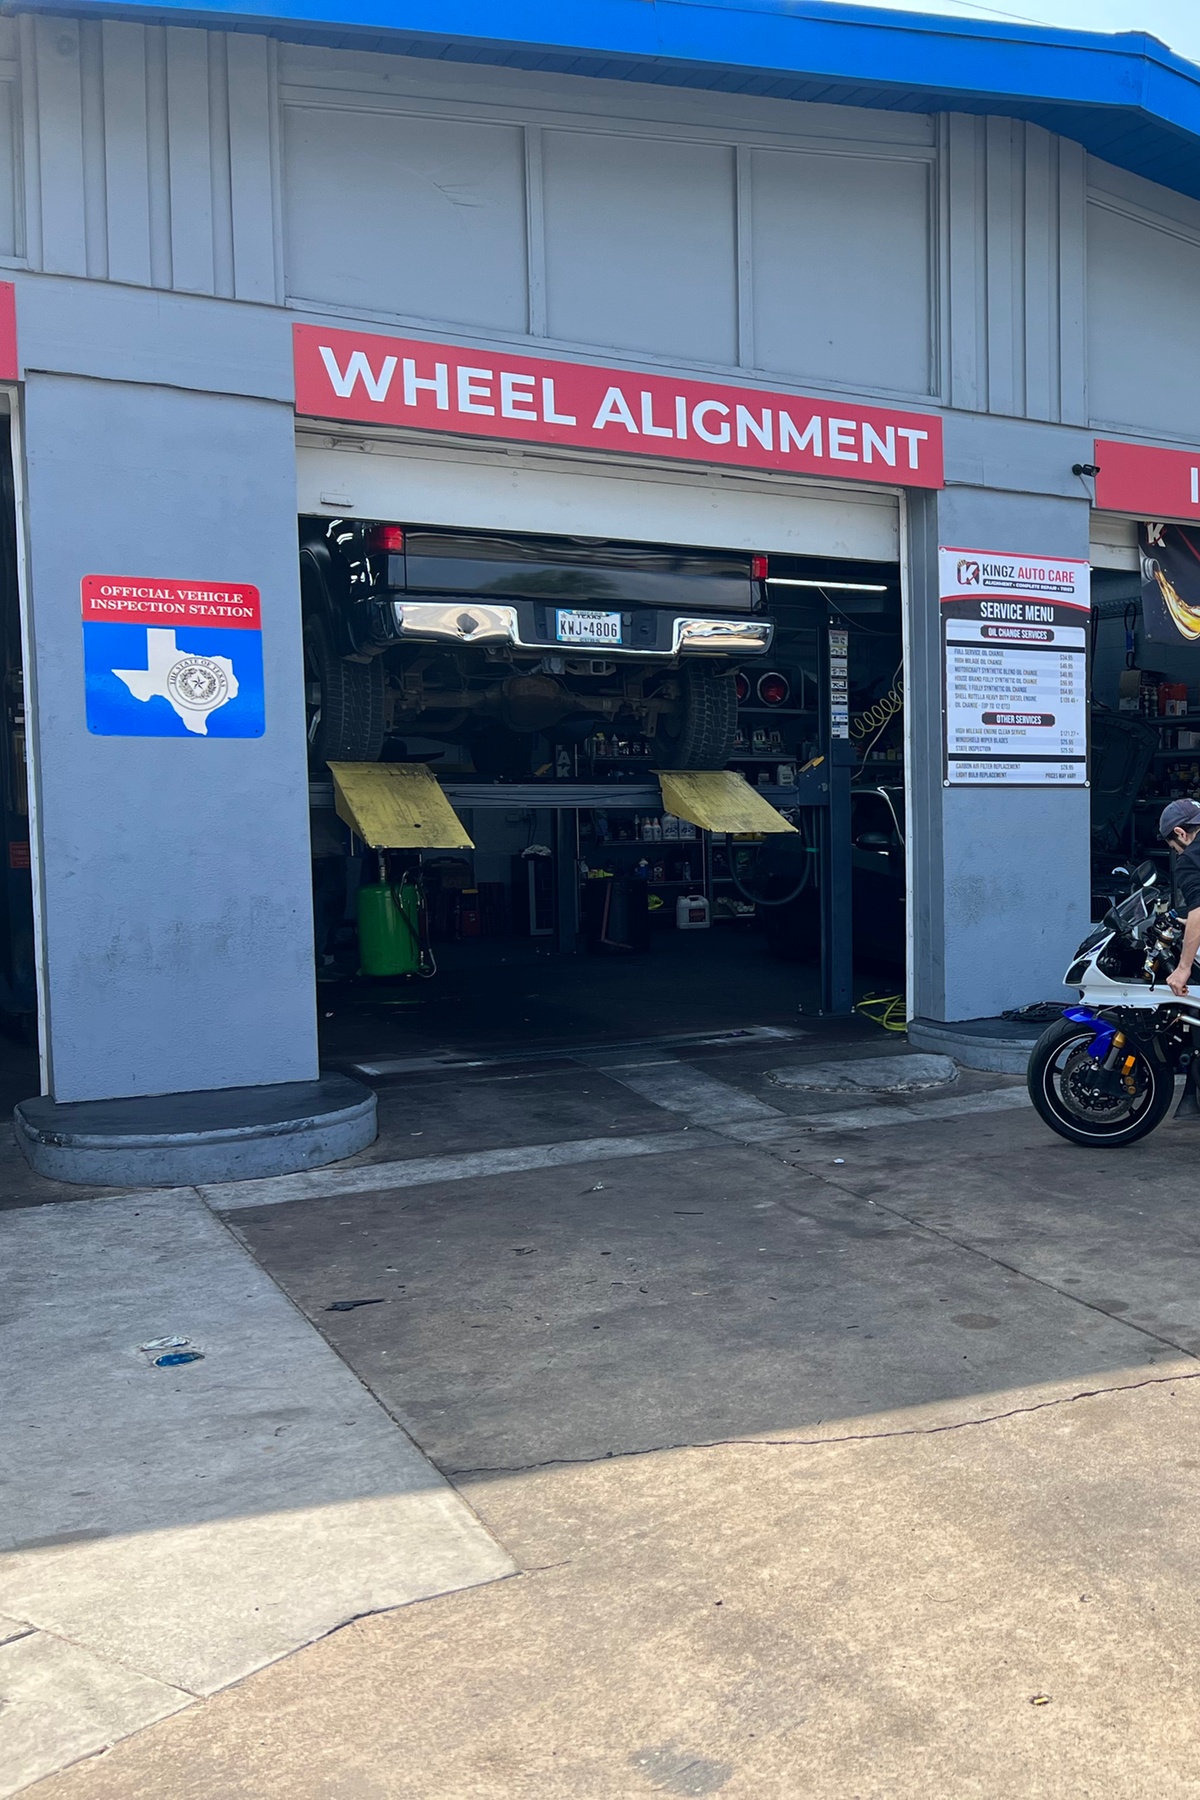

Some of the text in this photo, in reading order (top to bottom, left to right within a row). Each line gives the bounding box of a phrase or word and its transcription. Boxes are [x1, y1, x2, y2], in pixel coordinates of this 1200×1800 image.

[318, 346, 928, 469] WHEEL ALIGNMENT
[983, 564, 1014, 578] KINGZ
[1018, 567, 1044, 581] AUTO
[1048, 570, 1074, 583] CARE
[100, 586, 243, 603] OFFICIAL VEHICLE
[90, 599, 253, 617] INSPECTION STATION
[980, 602, 1054, 622] SERVICE MENU
[988, 628, 1047, 640] OIL CHANGE SERVICES
[176, 660, 198, 670] STATE
[996, 715, 1041, 724] OTHER SERVICES
